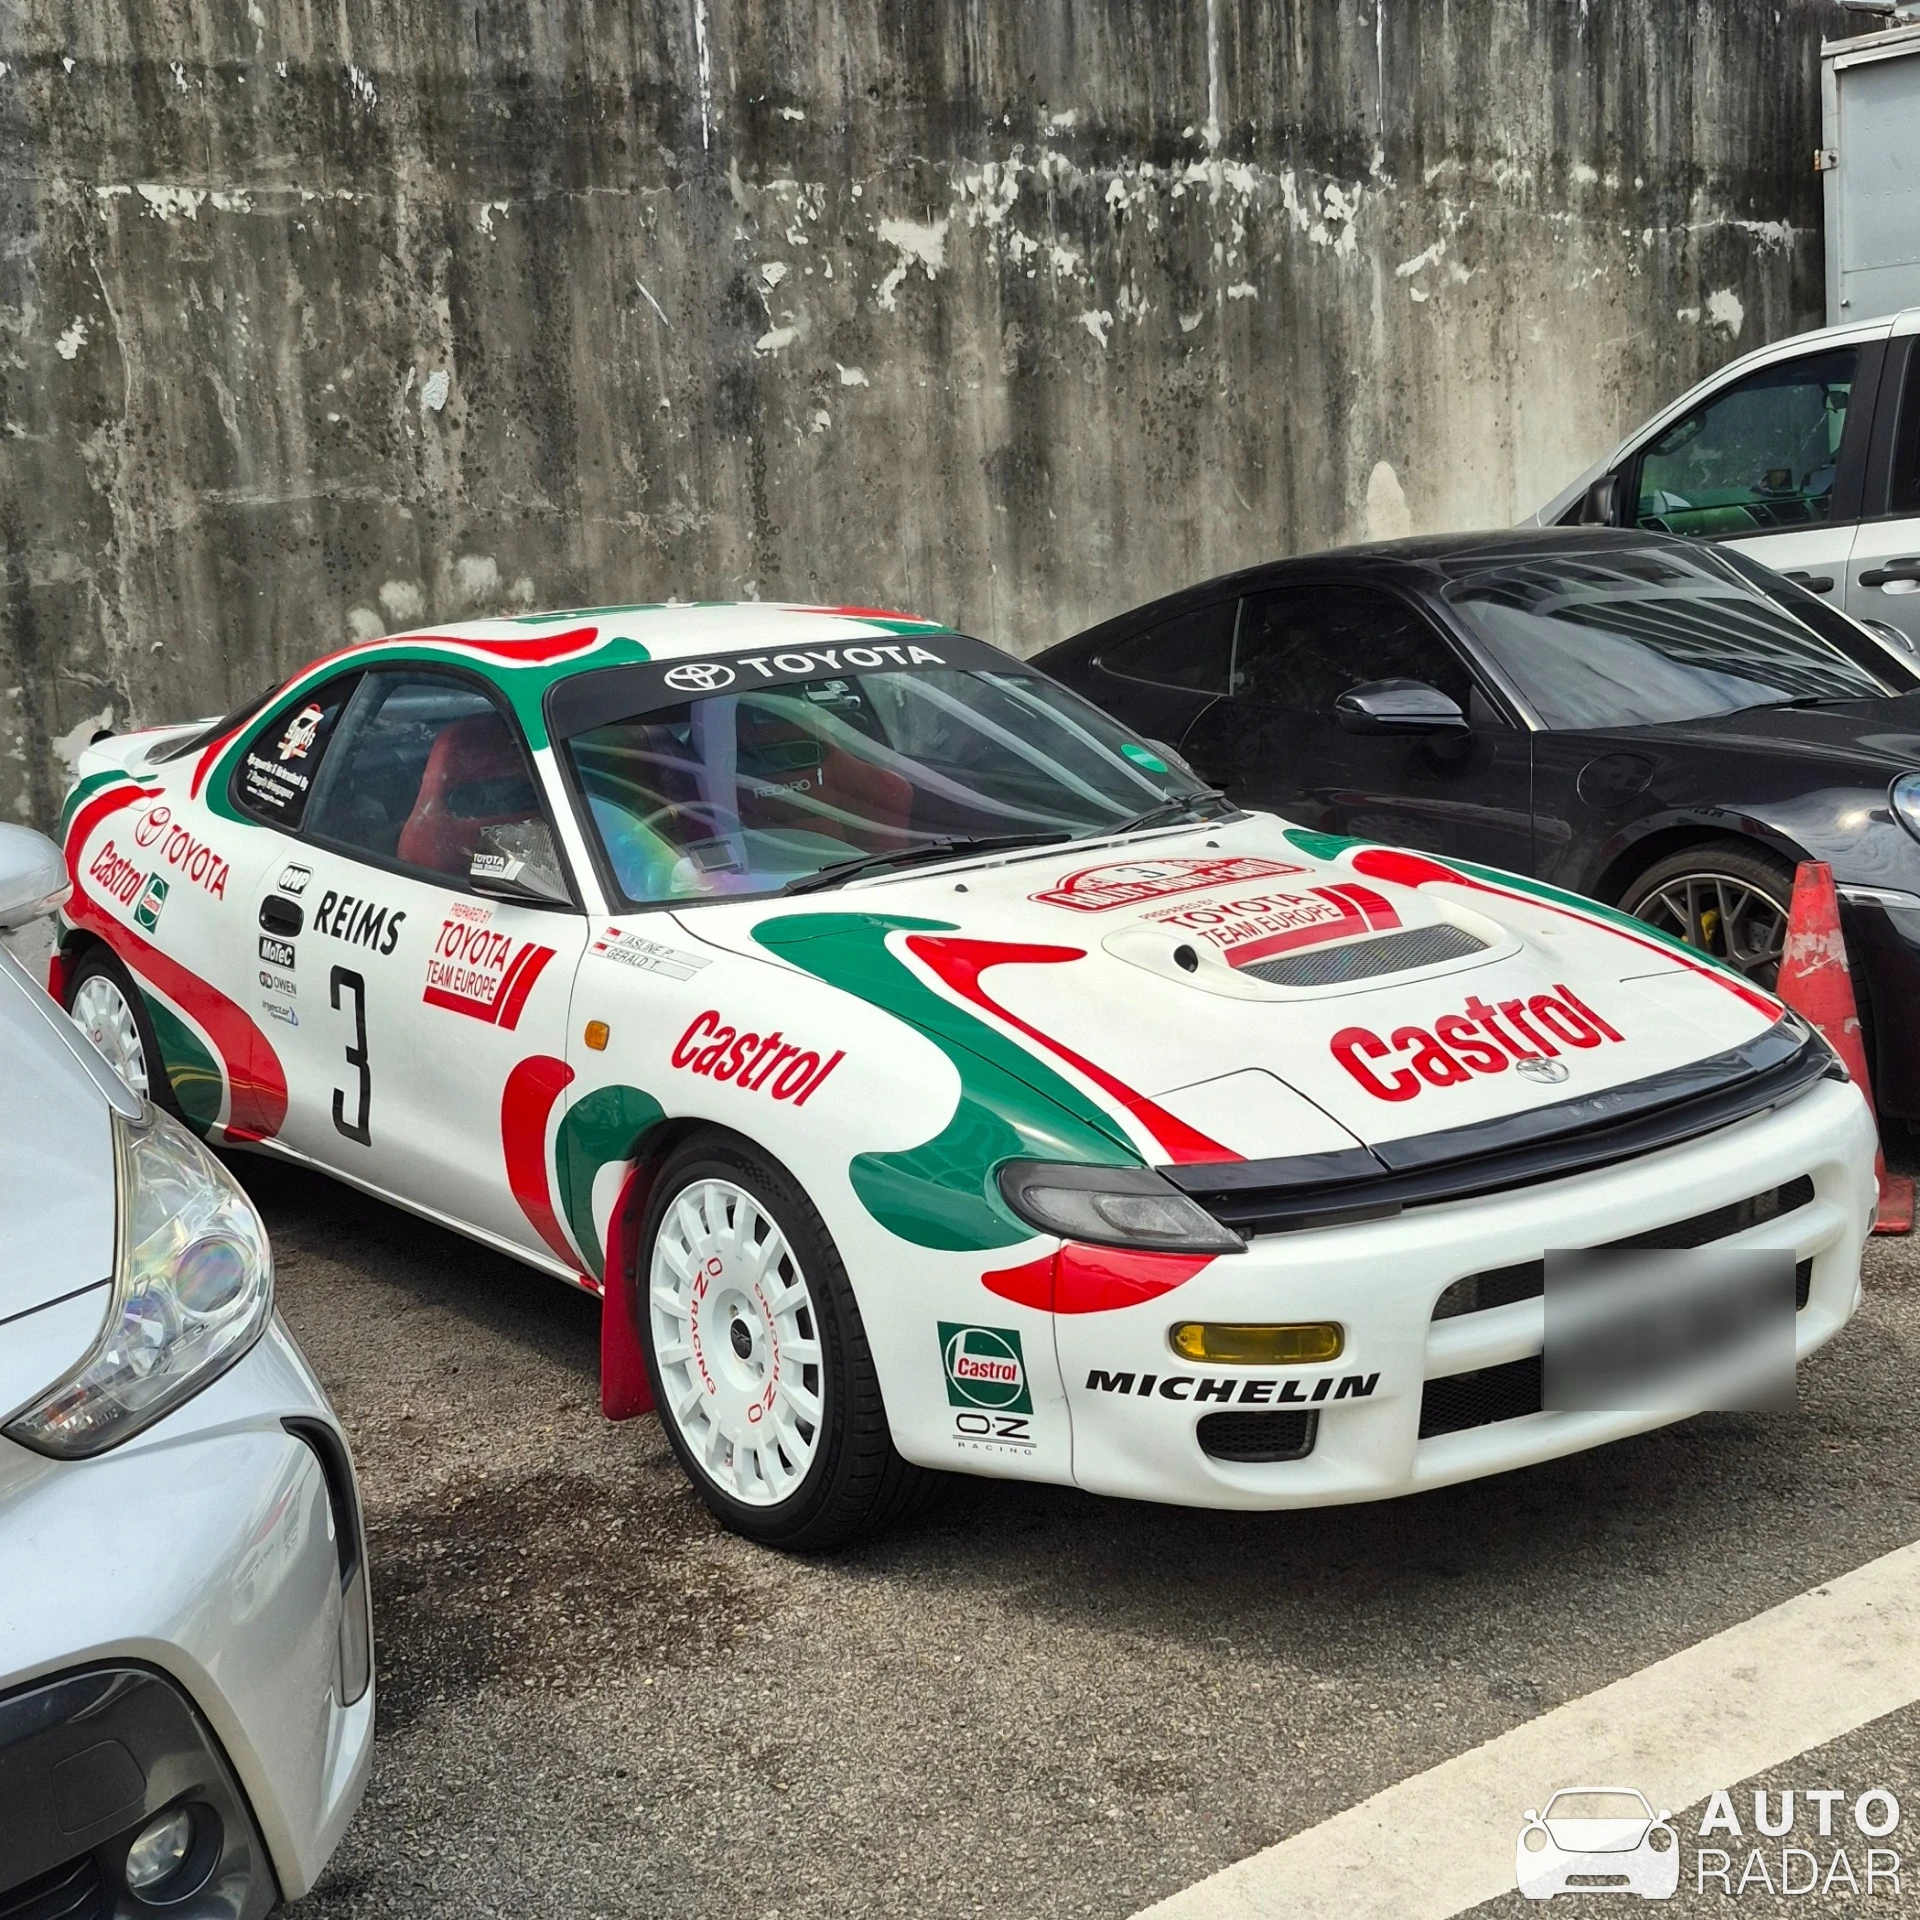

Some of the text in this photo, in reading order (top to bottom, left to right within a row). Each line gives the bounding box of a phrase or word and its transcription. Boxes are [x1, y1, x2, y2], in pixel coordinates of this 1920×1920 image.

[736, 645, 947, 678] TOYOTA
[753, 779, 811, 798] RECARO
[89, 840, 149, 907] Castrol
[160, 824, 230, 901] TOYOTA
[473, 853, 504, 866] TOYOTA
[1115, 867, 1167, 878] 3
[279, 867, 311, 891] OMP
[313, 890, 407, 956] REIMS
[1158, 893, 1319, 929] TOYOTA
[1197, 904, 1341, 948] TEAM EUROPE
[261, 939, 293, 965] MoTeC
[435, 920, 513, 972] TOYOTA
[606, 948, 649, 967] GERALD
[274, 976, 297, 995] OWEN
[426, 959, 497, 1001] TEAM EUROPE
[330, 964, 372, 1148] 3
[671, 1009, 847, 1107] Castrol
[1329, 984, 1626, 1102] Castrol
[691, 1299, 717, 1395] RACING
[755, 1282, 780, 1381] RACING
[957, 1357, 1017, 1381] Castrol
[1085, 1369, 1381, 1403] MICHELIN
[957, 1441, 1032, 1456] RACING
